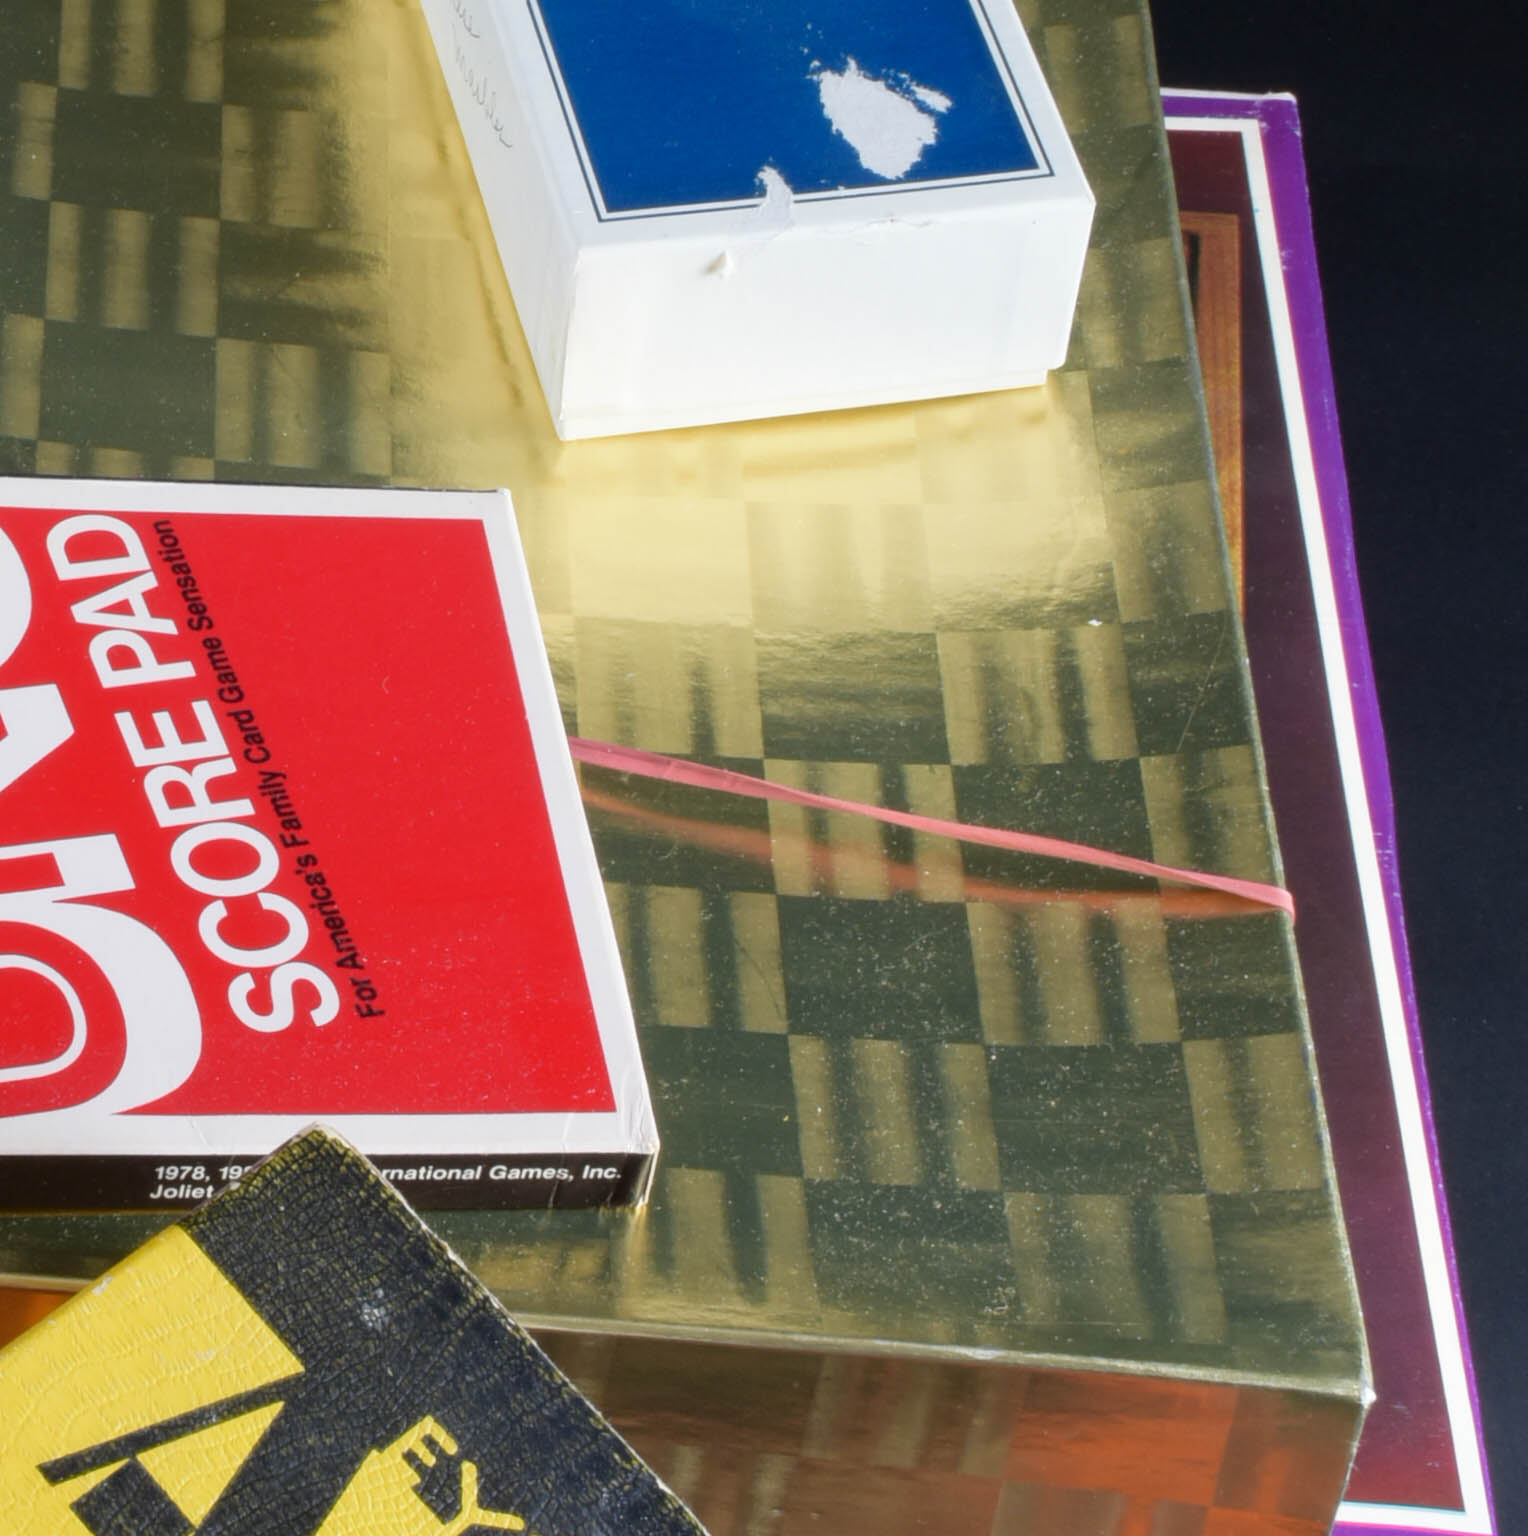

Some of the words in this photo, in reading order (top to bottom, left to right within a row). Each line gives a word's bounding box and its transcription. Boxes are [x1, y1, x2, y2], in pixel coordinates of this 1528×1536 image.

[45, 513, 196, 690] PAD
[152, 518, 215, 634] Sensation
[200, 636, 246, 705] Game
[226, 708, 273, 765] Card
[258, 770, 311, 850] Family
[117, 700, 341, 1034] SCORE
[295, 852, 367, 973] America's
[350, 977, 386, 1020] For
[154, 1165, 211, 1182] 1978,
[488, 1163, 575, 1184] Games,
[581, 1164, 623, 1182] Inc.
